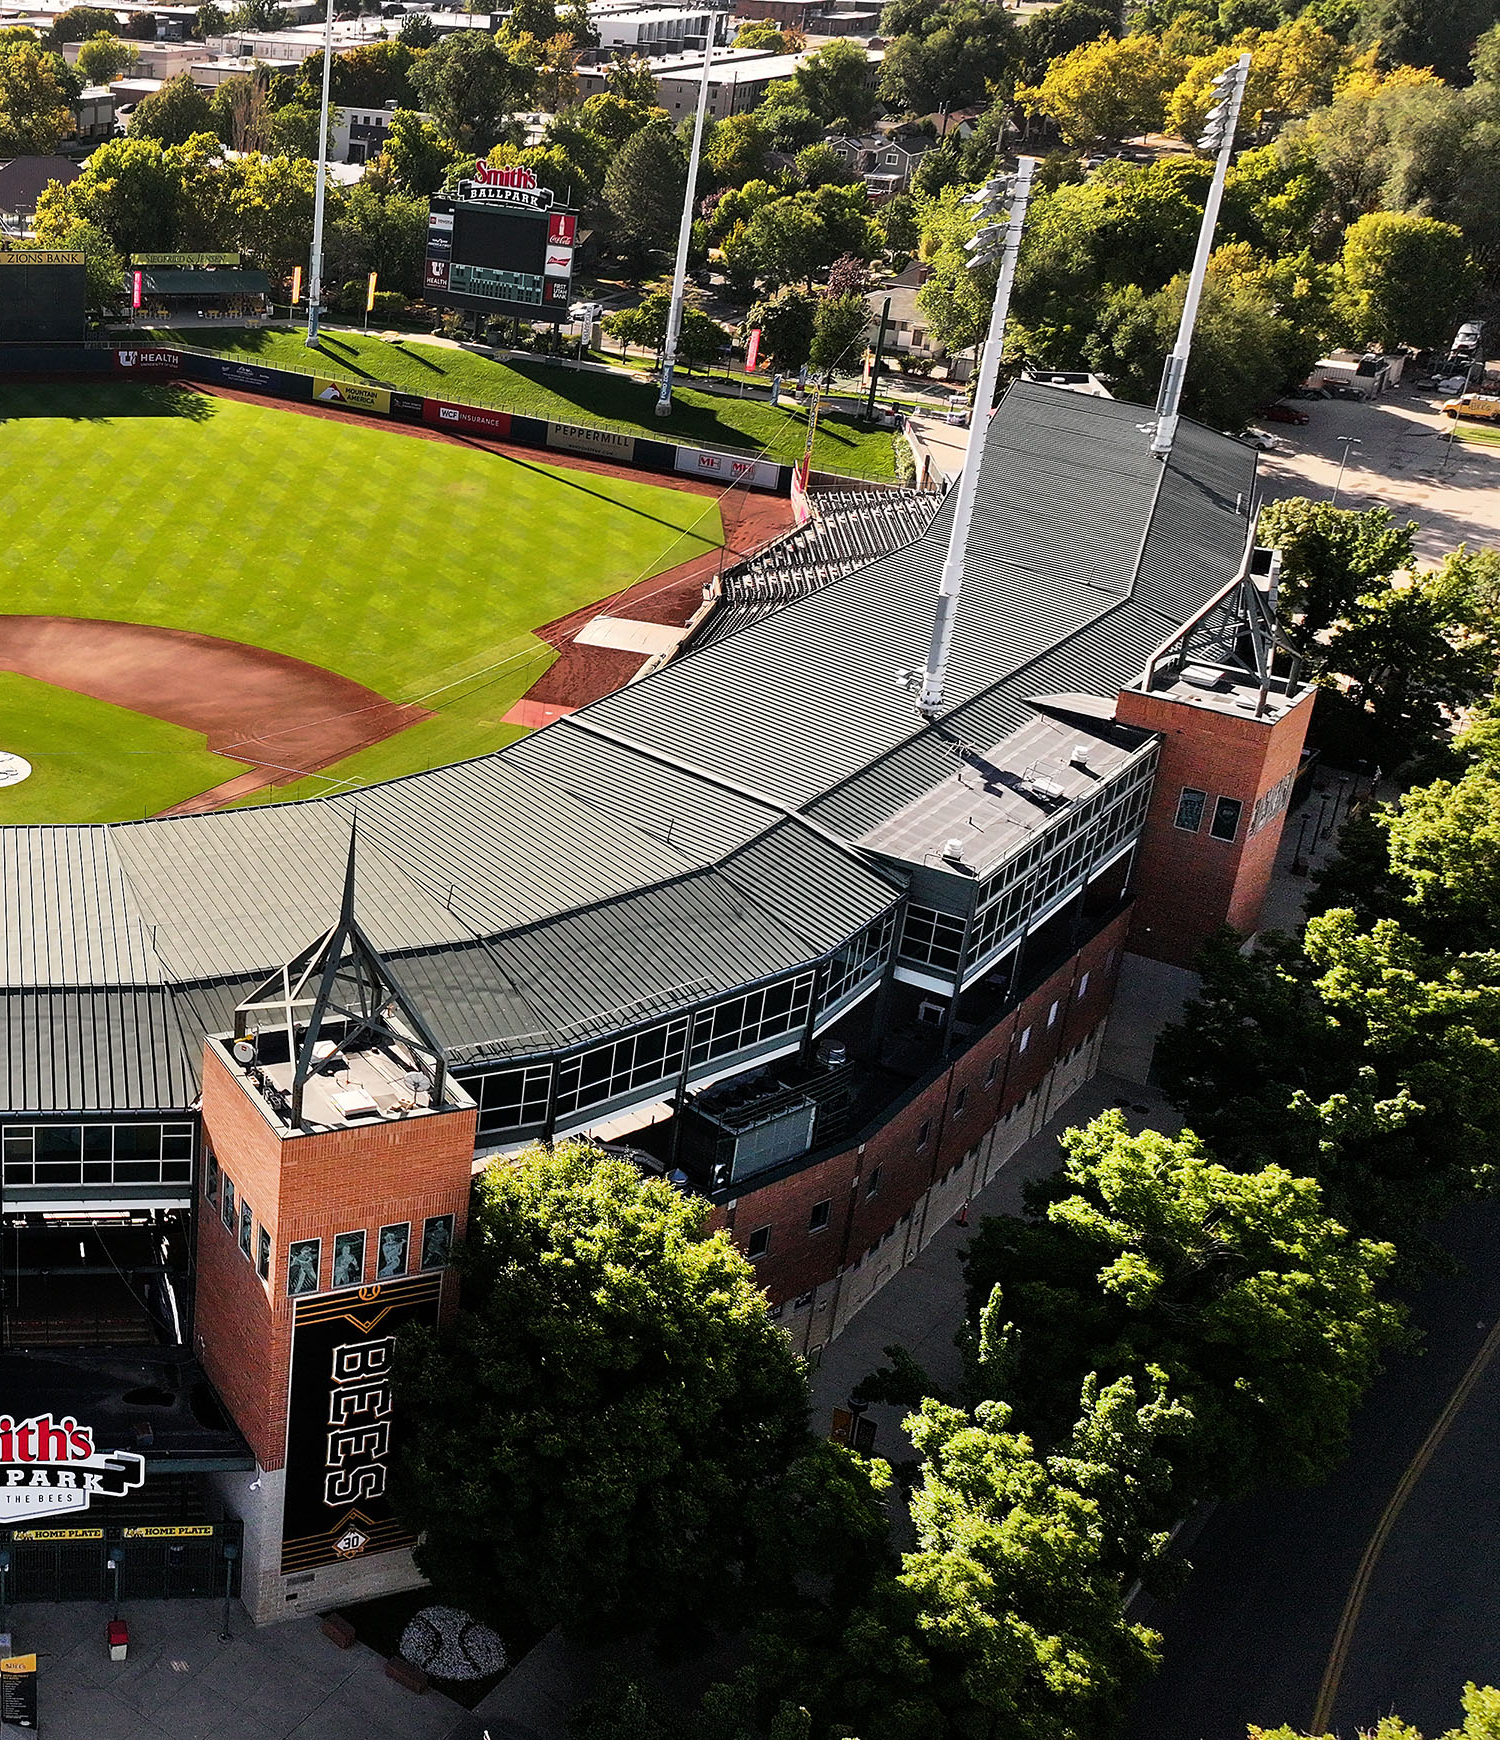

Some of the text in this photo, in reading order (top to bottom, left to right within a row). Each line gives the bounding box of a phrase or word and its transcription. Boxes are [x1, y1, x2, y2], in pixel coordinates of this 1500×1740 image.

[475, 160, 536, 189] Smith's
[470, 188, 539, 206] BALLPARK
[7, 253, 44, 264] ZIONS
[46, 253, 79, 263] BANK
[197, 253, 226, 264] JENSEN
[427, 278, 447, 286] HEALTH
[140, 353, 179, 364] HEALTH
[345, 387, 378, 399] MOUNTAIN
[346, 395, 375, 405] AMERICA
[441, 408, 499, 427] WCF INSURANCE
[555, 425, 629, 447] PEPPERMILL
[323, 1336, 397, 1508] BEES
[6, 1494, 31, 1505] THE
[39, 1493, 73, 1504] BEES
[35, 1529, 101, 1538] HOME PLATE
[144, 1527, 211, 1536] HOME PLATE
[342, 1536, 359, 1550] 30
